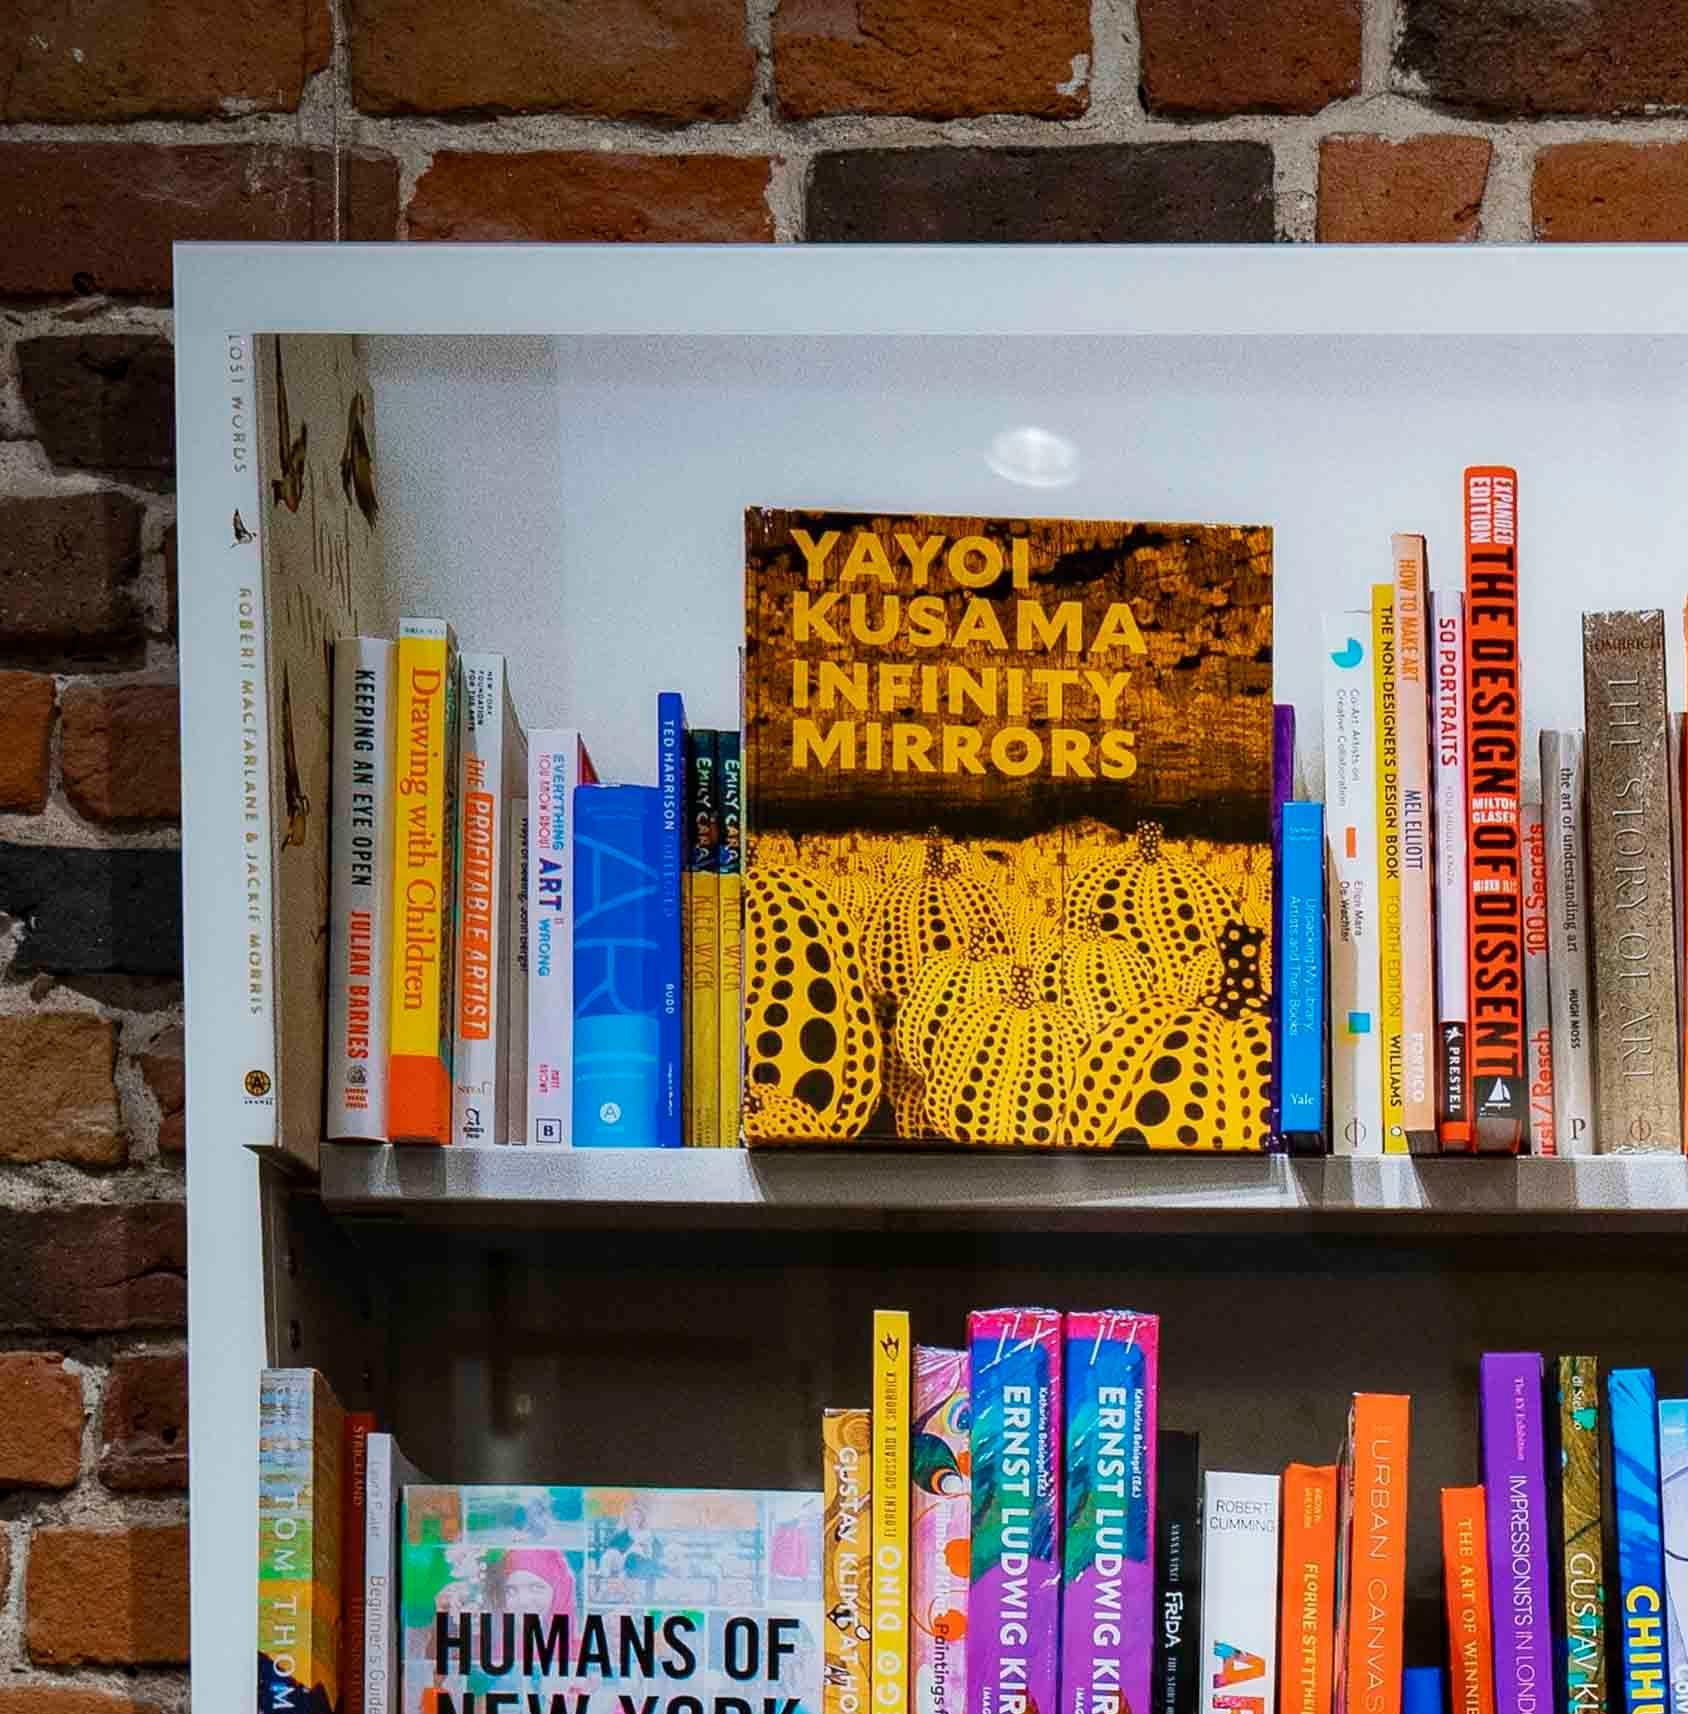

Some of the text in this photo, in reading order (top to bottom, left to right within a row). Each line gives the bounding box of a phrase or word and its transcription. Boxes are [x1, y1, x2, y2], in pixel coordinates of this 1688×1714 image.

[790, 531, 1030, 589] YAYOI
[793, 592, 1148, 655] KUSAMA
[792, 659, 1132, 720] INFINITY
[350, 669, 376, 886] KEEPING AN EYE OPEN
[791, 719, 1137, 779] MIRRORS
[399, 667, 441, 1011] Drawing with Children
[1471, 548, 1518, 1078] THE DESIGN OF DISSENT
[348, 911, 371, 1058] JULIAN BARNES
[1000, 1385, 1031, 1498] ERNST
[272, 1495, 296, 1571] TOM
[998, 1507, 1030, 1647] LUDWIG
[1366, 1439, 1392, 1713] URBAN CANVAS
[1508, 1475, 1532, 1625] IMPRESSIONISTS
[436, 1611, 800, 1682] HUMANS OF
[1513, 1631, 1534, 1650] IN
[1569, 1553, 1598, 1670] GUSTAV
